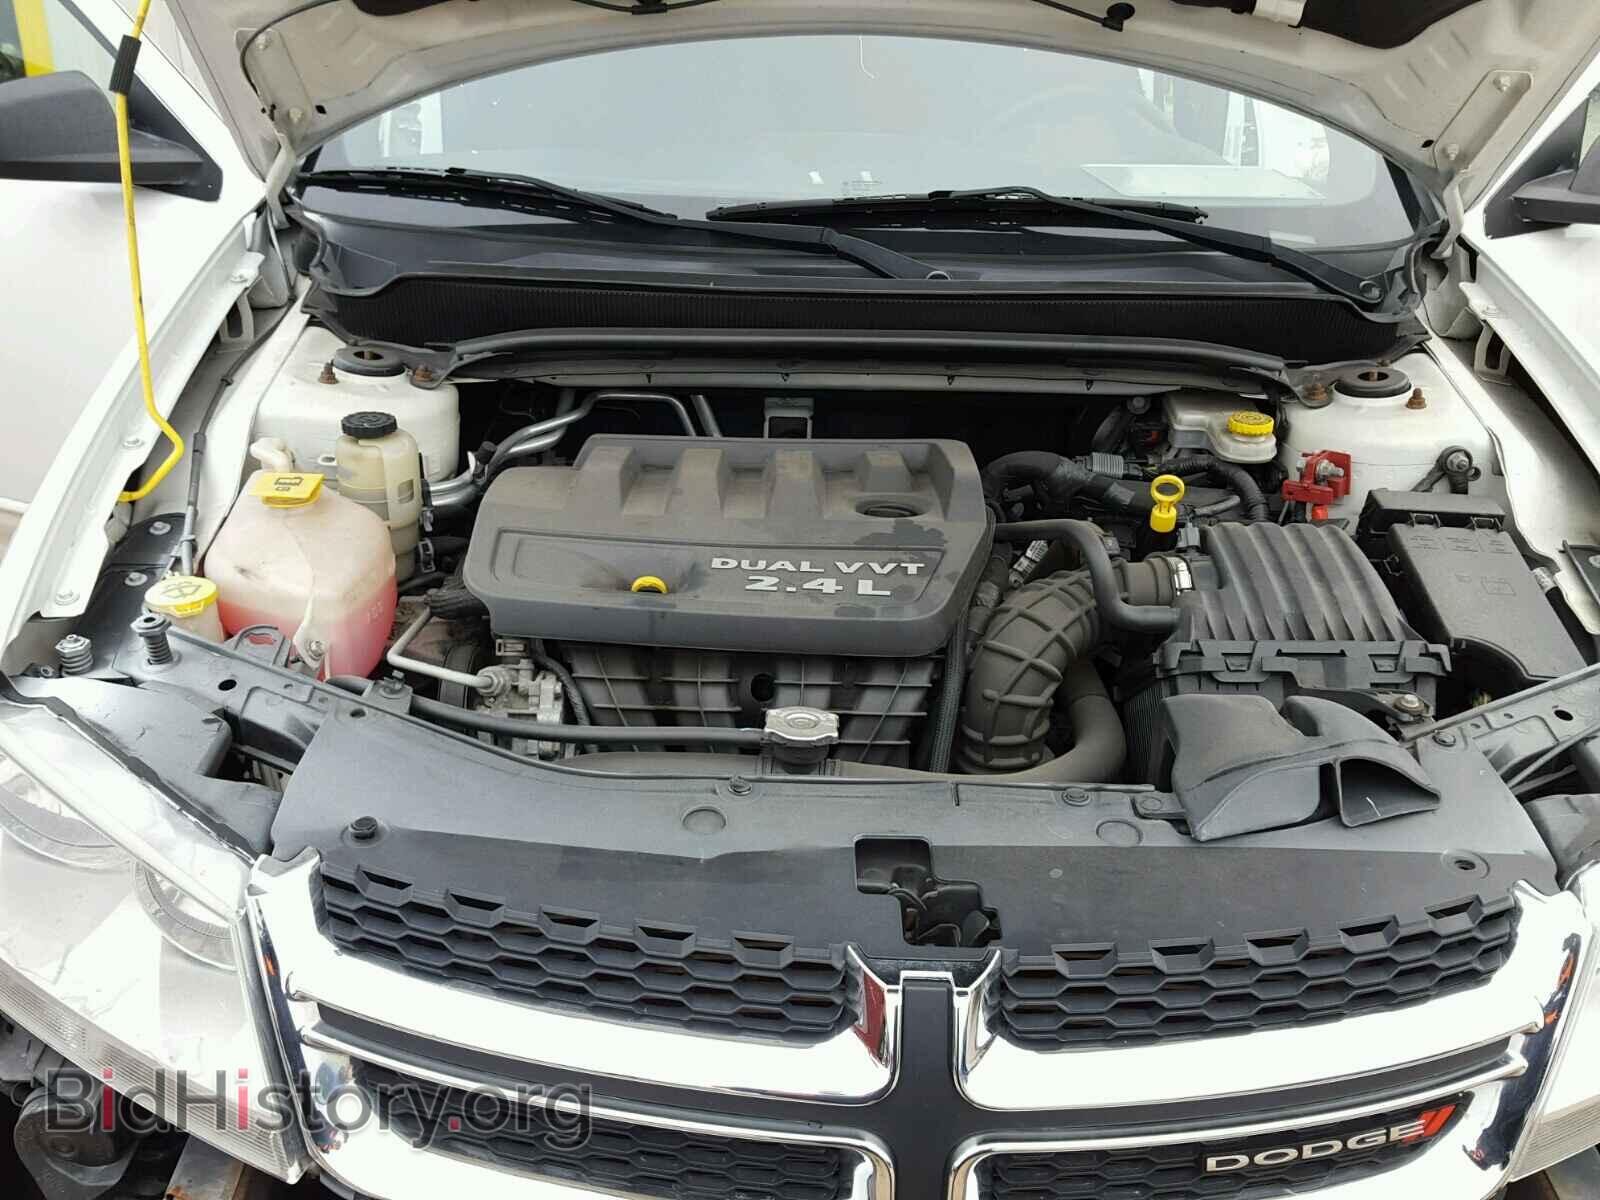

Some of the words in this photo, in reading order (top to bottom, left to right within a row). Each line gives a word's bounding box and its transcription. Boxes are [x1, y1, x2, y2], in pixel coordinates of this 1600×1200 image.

[711, 557, 824, 573] DUAL
[834, 561, 925, 575] VVT
[745, 575, 843, 594] 2.4
[1206, 1119, 1426, 1172] DODGE
